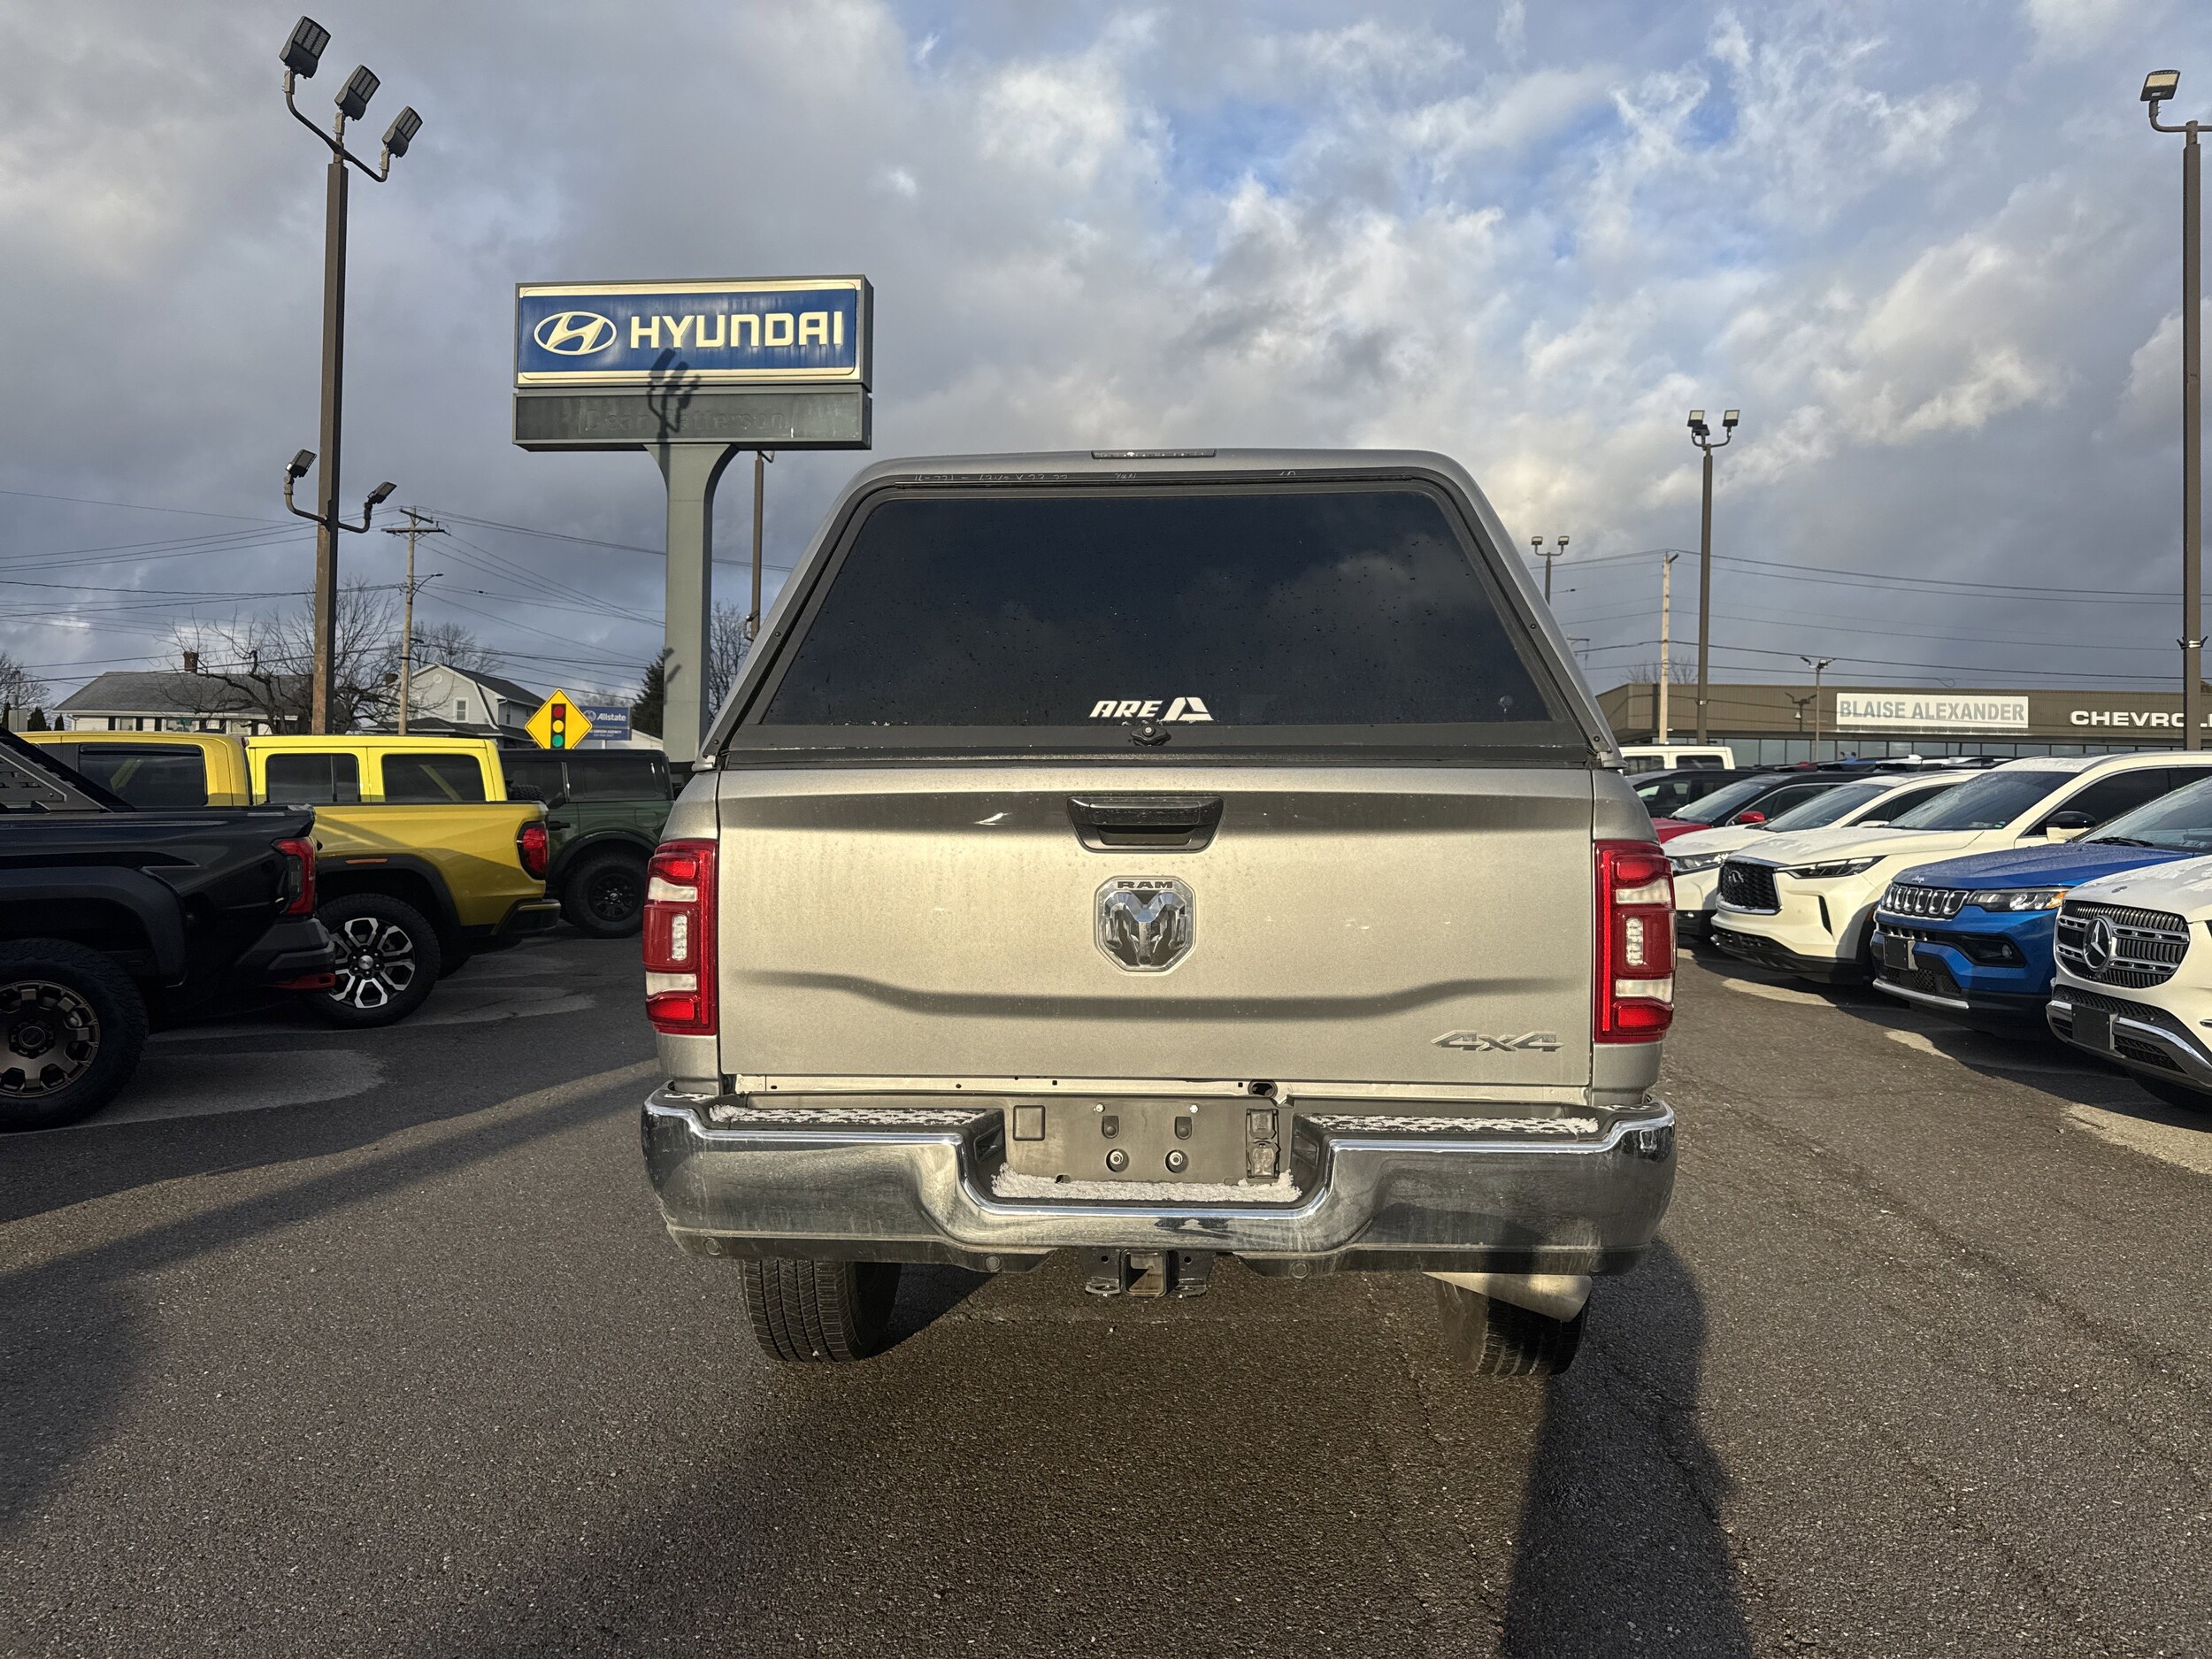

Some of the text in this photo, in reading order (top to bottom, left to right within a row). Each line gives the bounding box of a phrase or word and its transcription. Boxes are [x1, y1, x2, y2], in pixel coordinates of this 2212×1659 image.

[630, 311, 843, 349] HYUNDAI
[596, 712, 626, 722] Allstate
[1088, 700, 1164, 718] ARE
[1839, 700, 2025, 721] BLAISE ALEXANDER
[2070, 710, 2212, 728] CHEVRO
